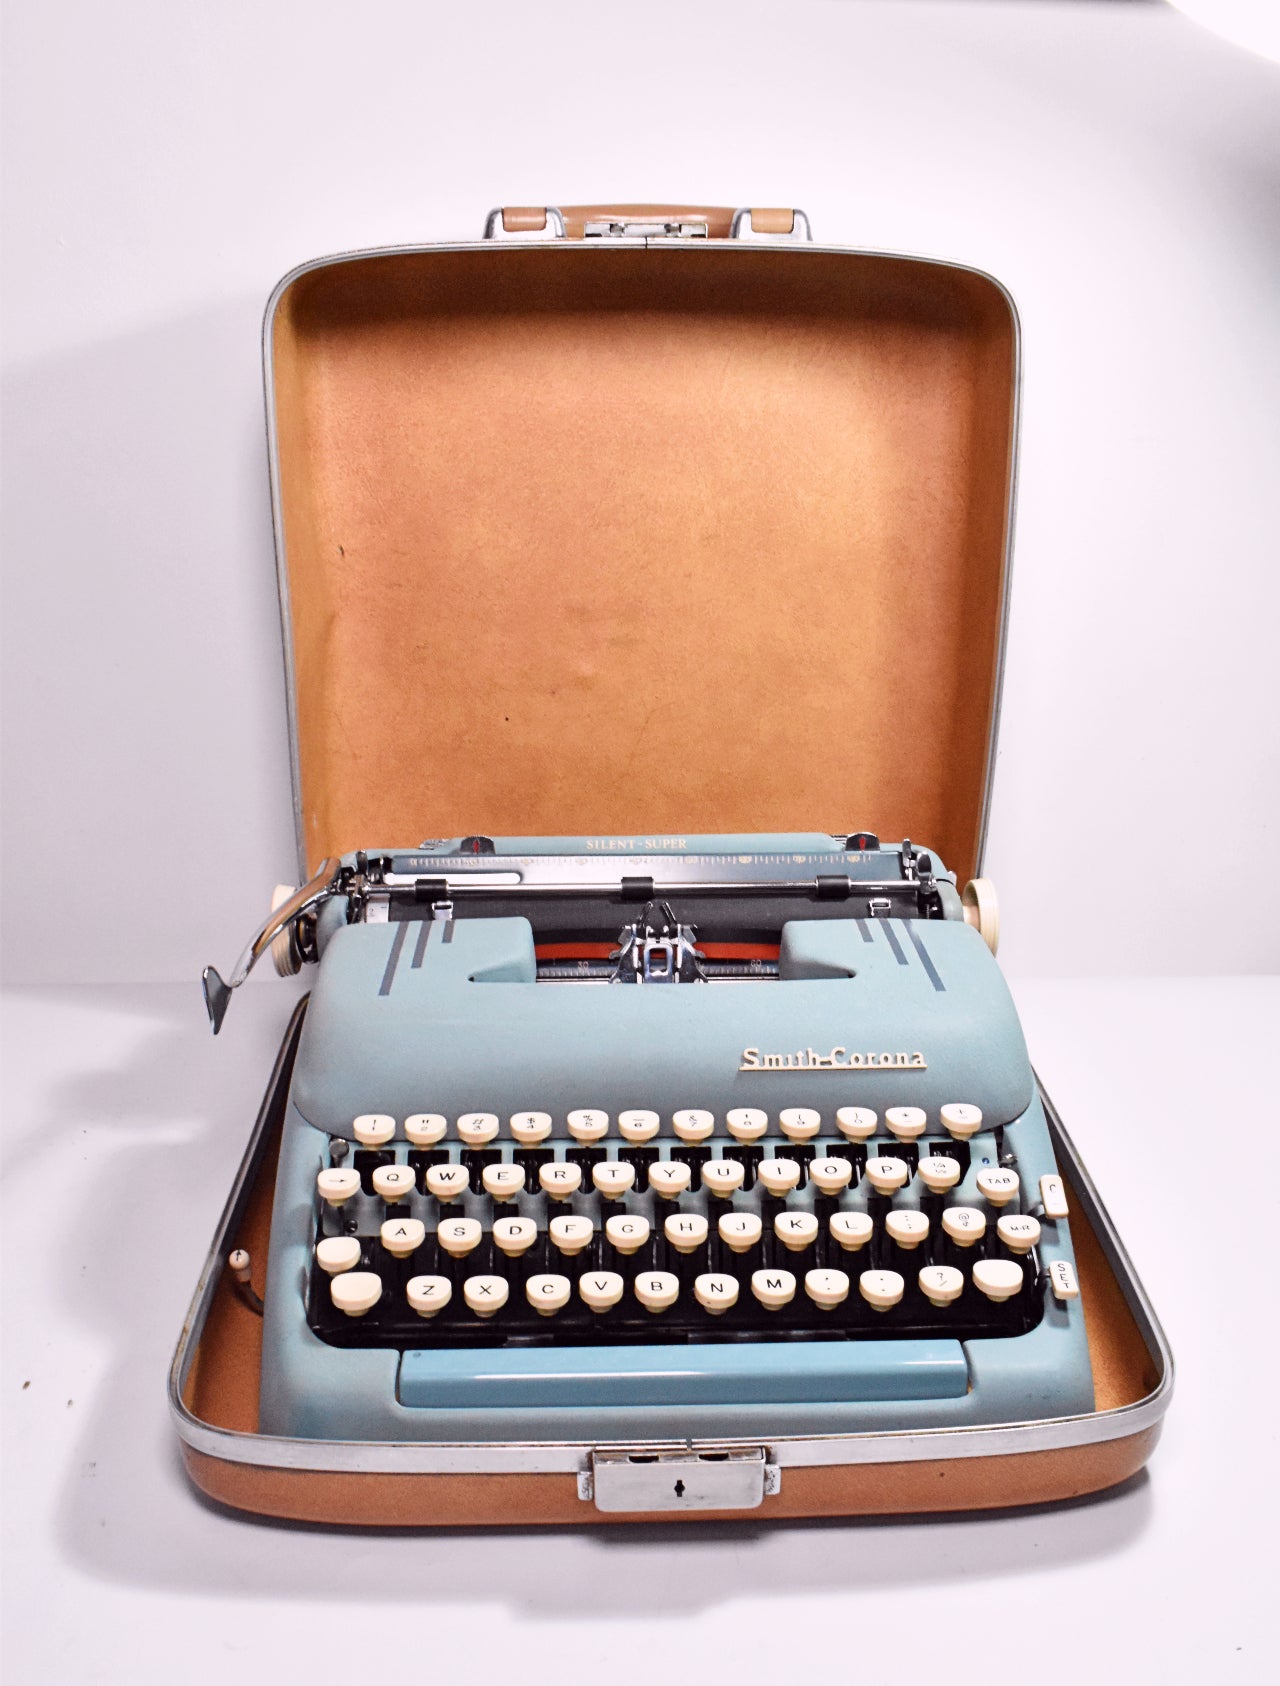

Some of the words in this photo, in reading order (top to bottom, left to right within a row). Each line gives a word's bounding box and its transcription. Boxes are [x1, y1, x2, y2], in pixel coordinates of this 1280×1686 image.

[577, 961, 589, 970] 30
[742, 1046, 926, 1068] Smith-Corona
[554, 1170, 566, 1179] R
[608, 1169, 619, 1178] T
[663, 1169, 676, 1178] Y
[717, 1168, 730, 1176] U
[777, 1166, 782, 1175] I
[824, 1165, 838, 1174] O
[881, 1165, 893, 1174] P
[386, 1173, 400, 1182] Q
[439, 1172, 456, 1181] W
[497, 1171, 508, 1181] E
[986, 1177, 1012, 1185] TAB
[564, 1224, 575, 1234] F
[621, 1224, 634, 1233] G
[679, 1222, 693, 1232] H
[736, 1221, 746, 1231] J
[790, 1219, 803, 1229] K
[845, 1220, 859, 1230] L
[394, 1227, 407, 1236] A
[453, 1226, 466, 1237] S
[509, 1225, 523, 1236] D
[1057, 1261, 1071, 1289] SET
[594, 1280, 608, 1291] V
[650, 1281, 663, 1291] B
[710, 1282, 724, 1293] N
[766, 1278, 782, 1289] M
[422, 1285, 436, 1296] Z
[479, 1285, 492, 1295] X
[541, 1284, 554, 1294] C
